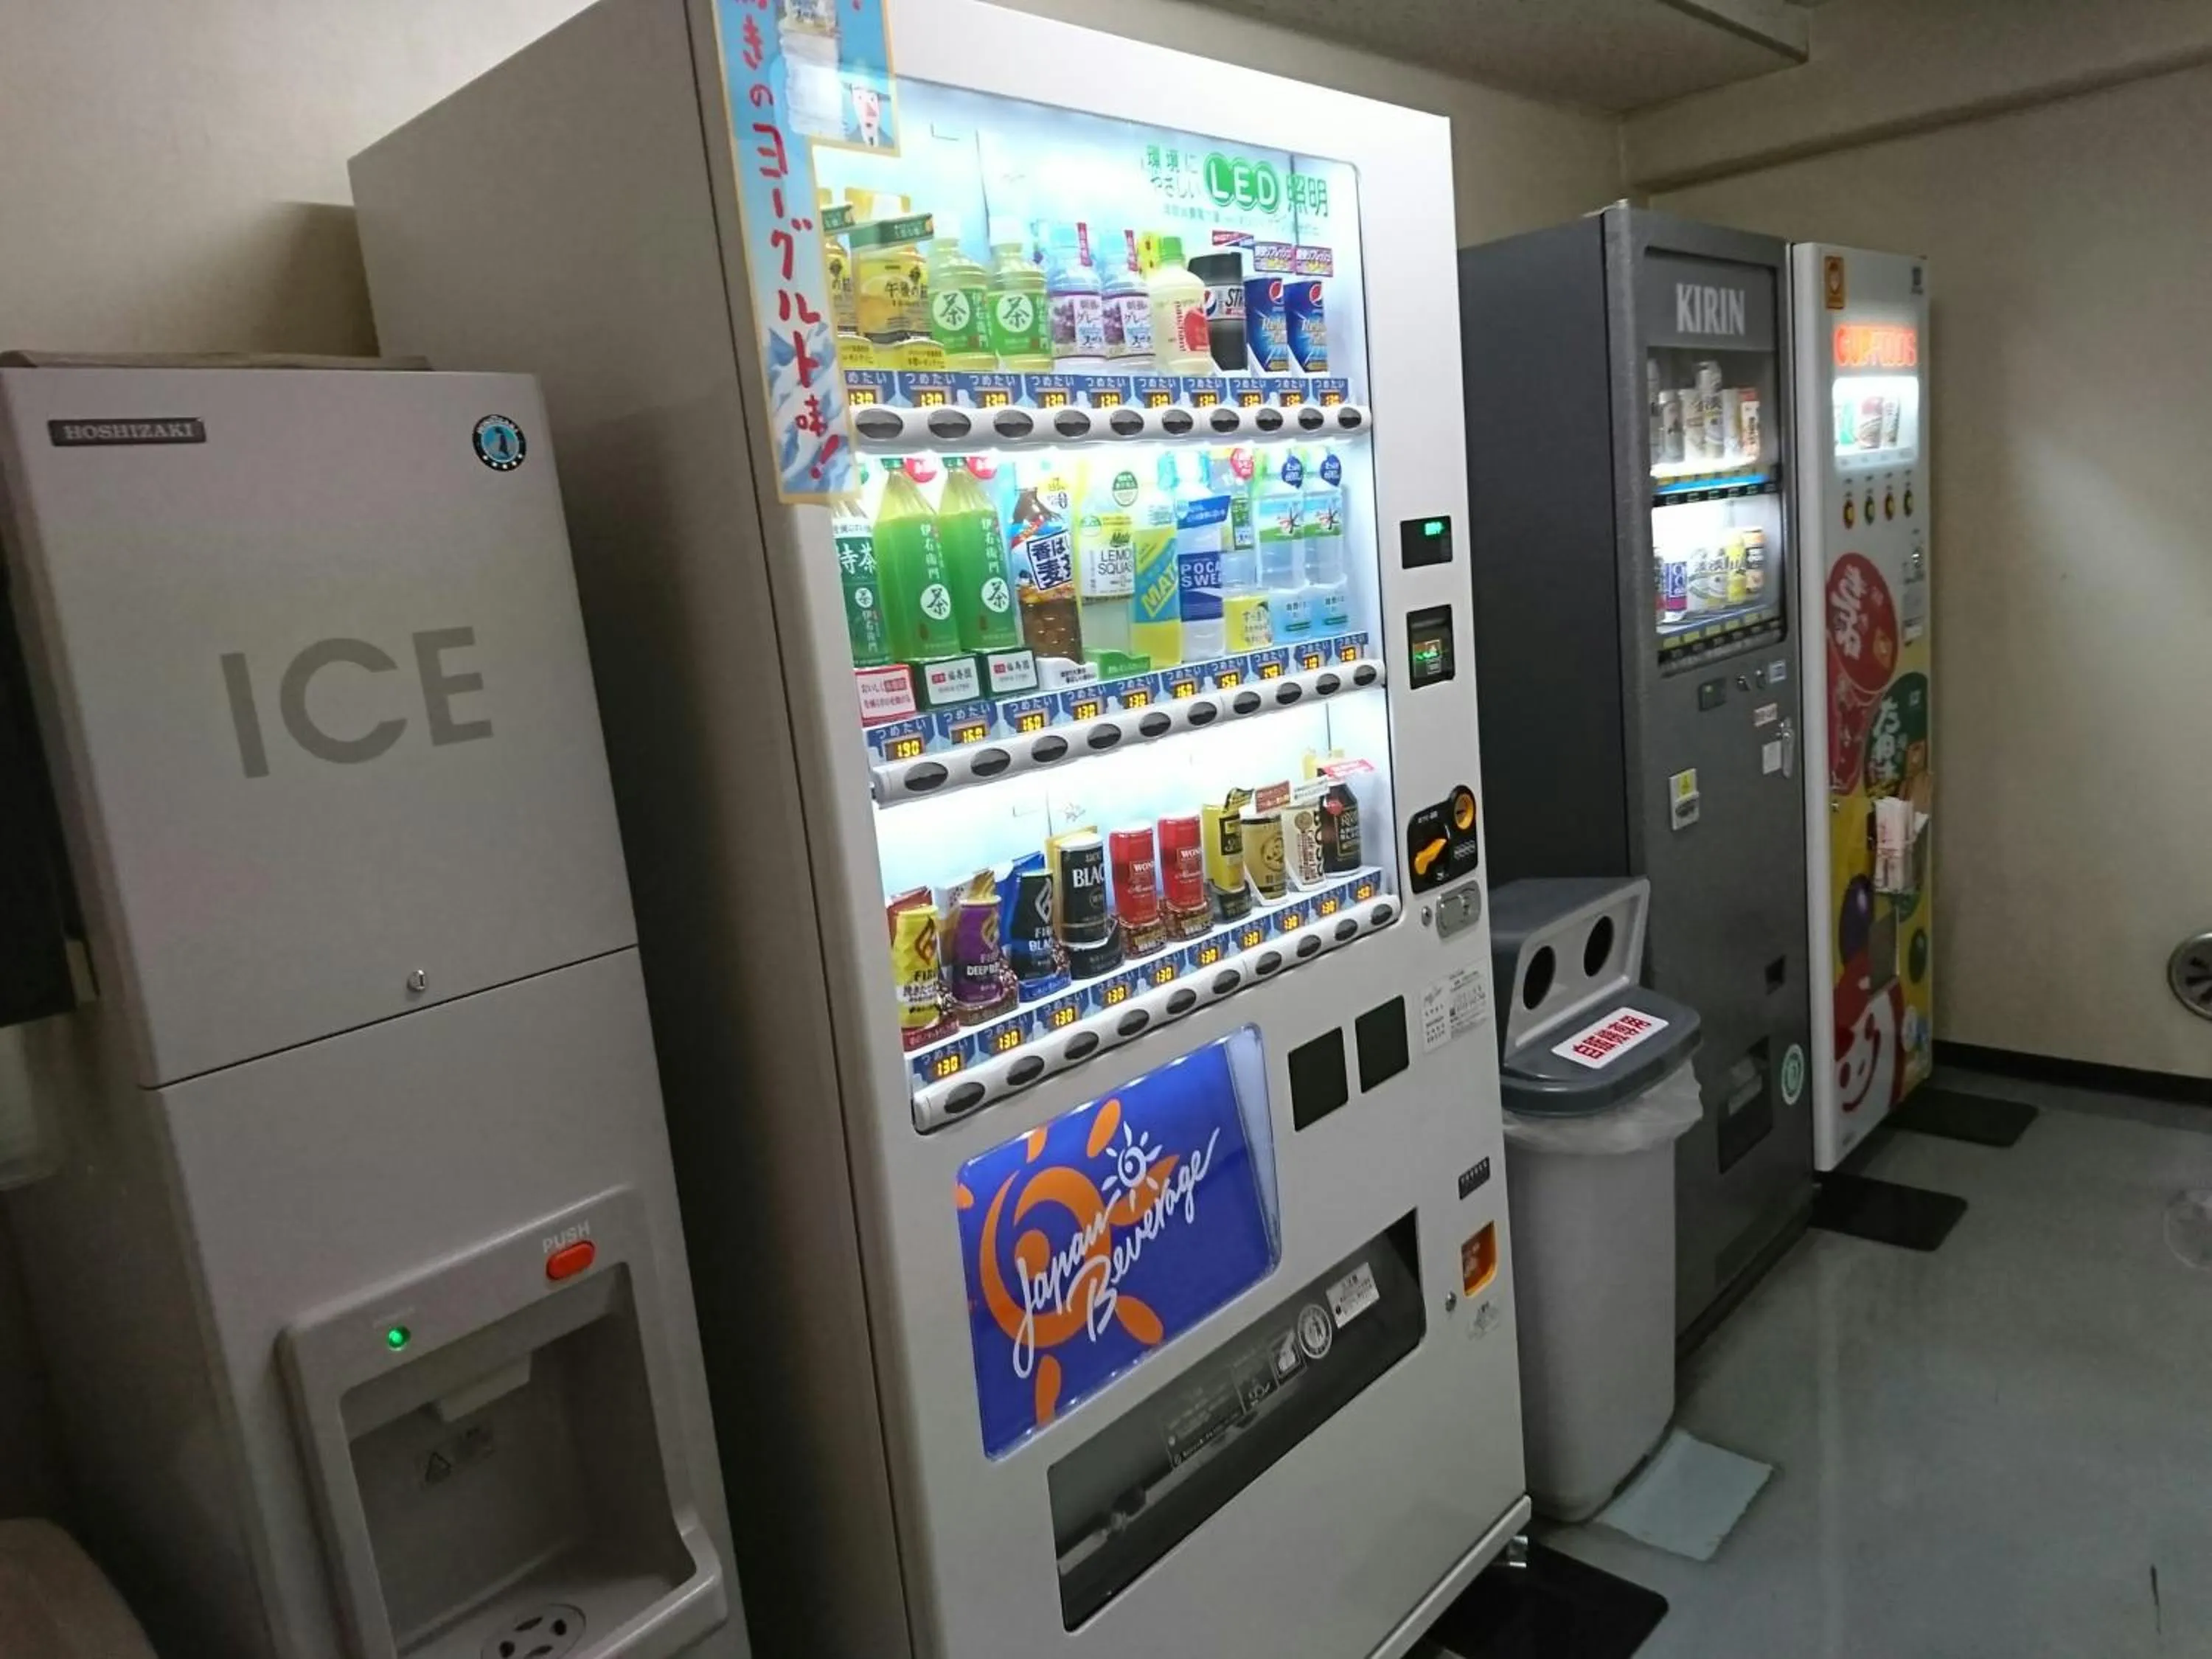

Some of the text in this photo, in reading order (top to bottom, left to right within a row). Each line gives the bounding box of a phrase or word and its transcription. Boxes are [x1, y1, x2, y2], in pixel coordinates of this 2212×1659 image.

[1208, 157, 1279, 209] LED
[939, 292, 967, 327] 茶
[1003, 296, 1030, 329] 茶
[1676, 283, 1745, 336] KIRIN
[905, 373, 956, 385] つめたい
[969, 375, 1015, 386] つめたい
[62, 423, 194, 440] HOSHIZAKI
[927, 588, 949, 616] 茶
[220, 626, 494, 779] ICE
[943, 701, 991, 723] つめたい
[1009, 696, 1053, 713] つめたい
[875, 718, 927, 740] つめたい
[897, 740, 919, 758] 190
[1155, 967, 1172, 984] 130
[1107, 987, 1125, 1004] 130
[1055, 1007, 1073, 1026] 130
[999, 1030, 1018, 1050] 130
[937, 1055, 959, 1077] 130
[543, 1219, 591, 1253] PUSH
[1065, 1127, 1221, 1343] Beverage
[1013, 1189, 1121, 1380] Japan
